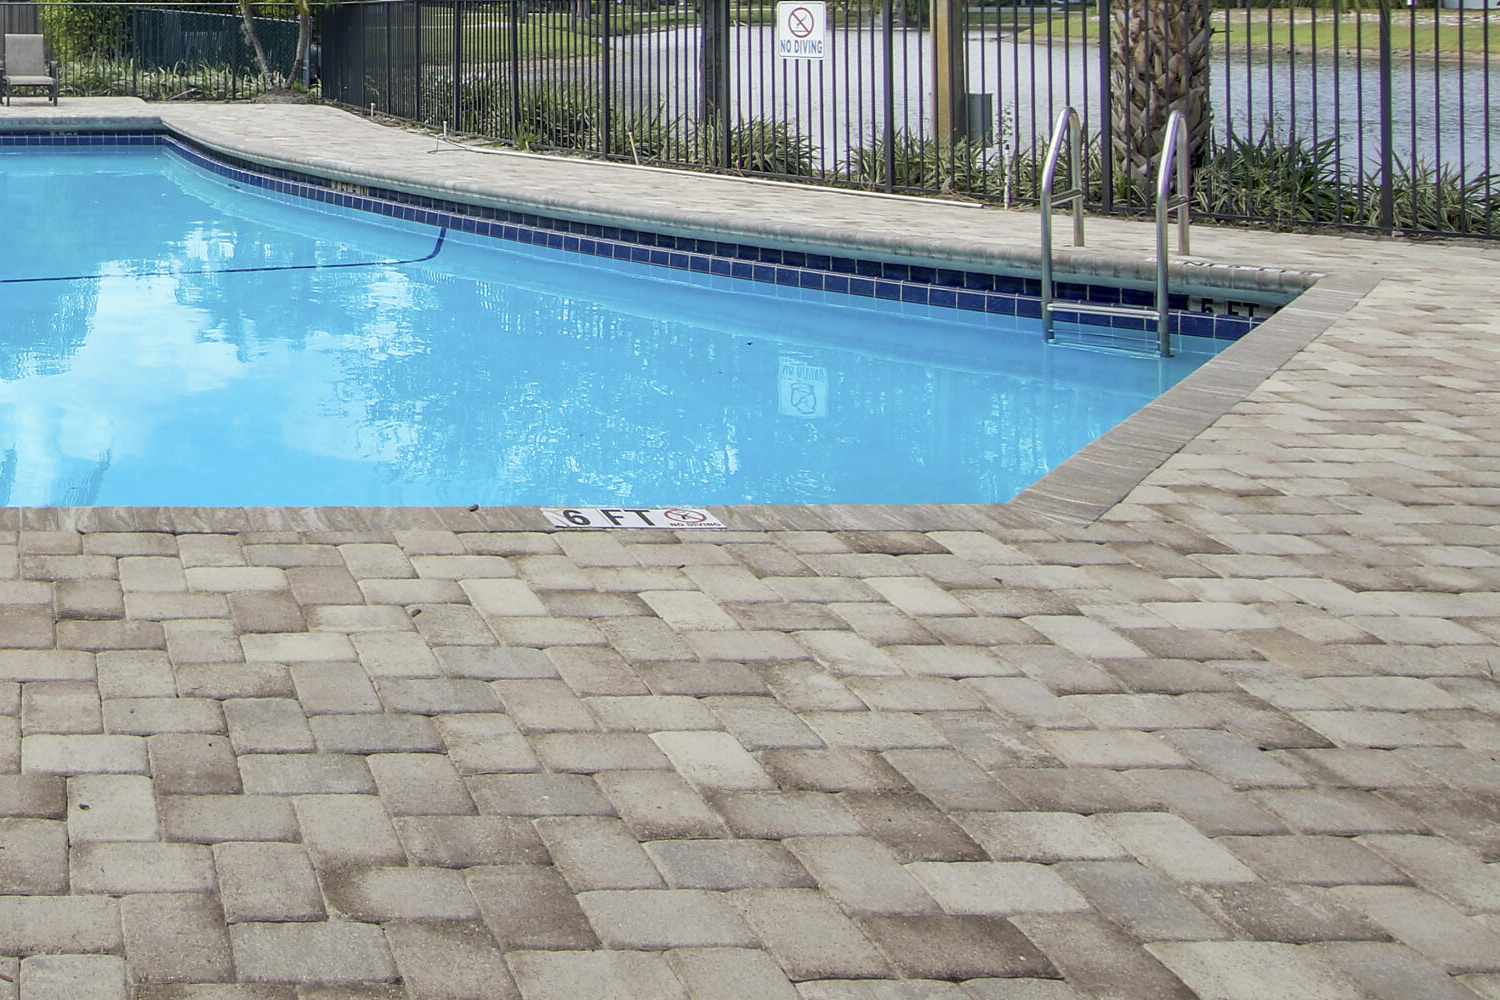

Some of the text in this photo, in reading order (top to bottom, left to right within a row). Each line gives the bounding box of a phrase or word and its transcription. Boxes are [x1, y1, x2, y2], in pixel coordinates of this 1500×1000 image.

[780, 40, 823, 54] NO DIVING
[1201, 297, 1214, 313] 5
[1227, 300, 1260, 317] FT
[563, 509, 656, 526] 6 FT
